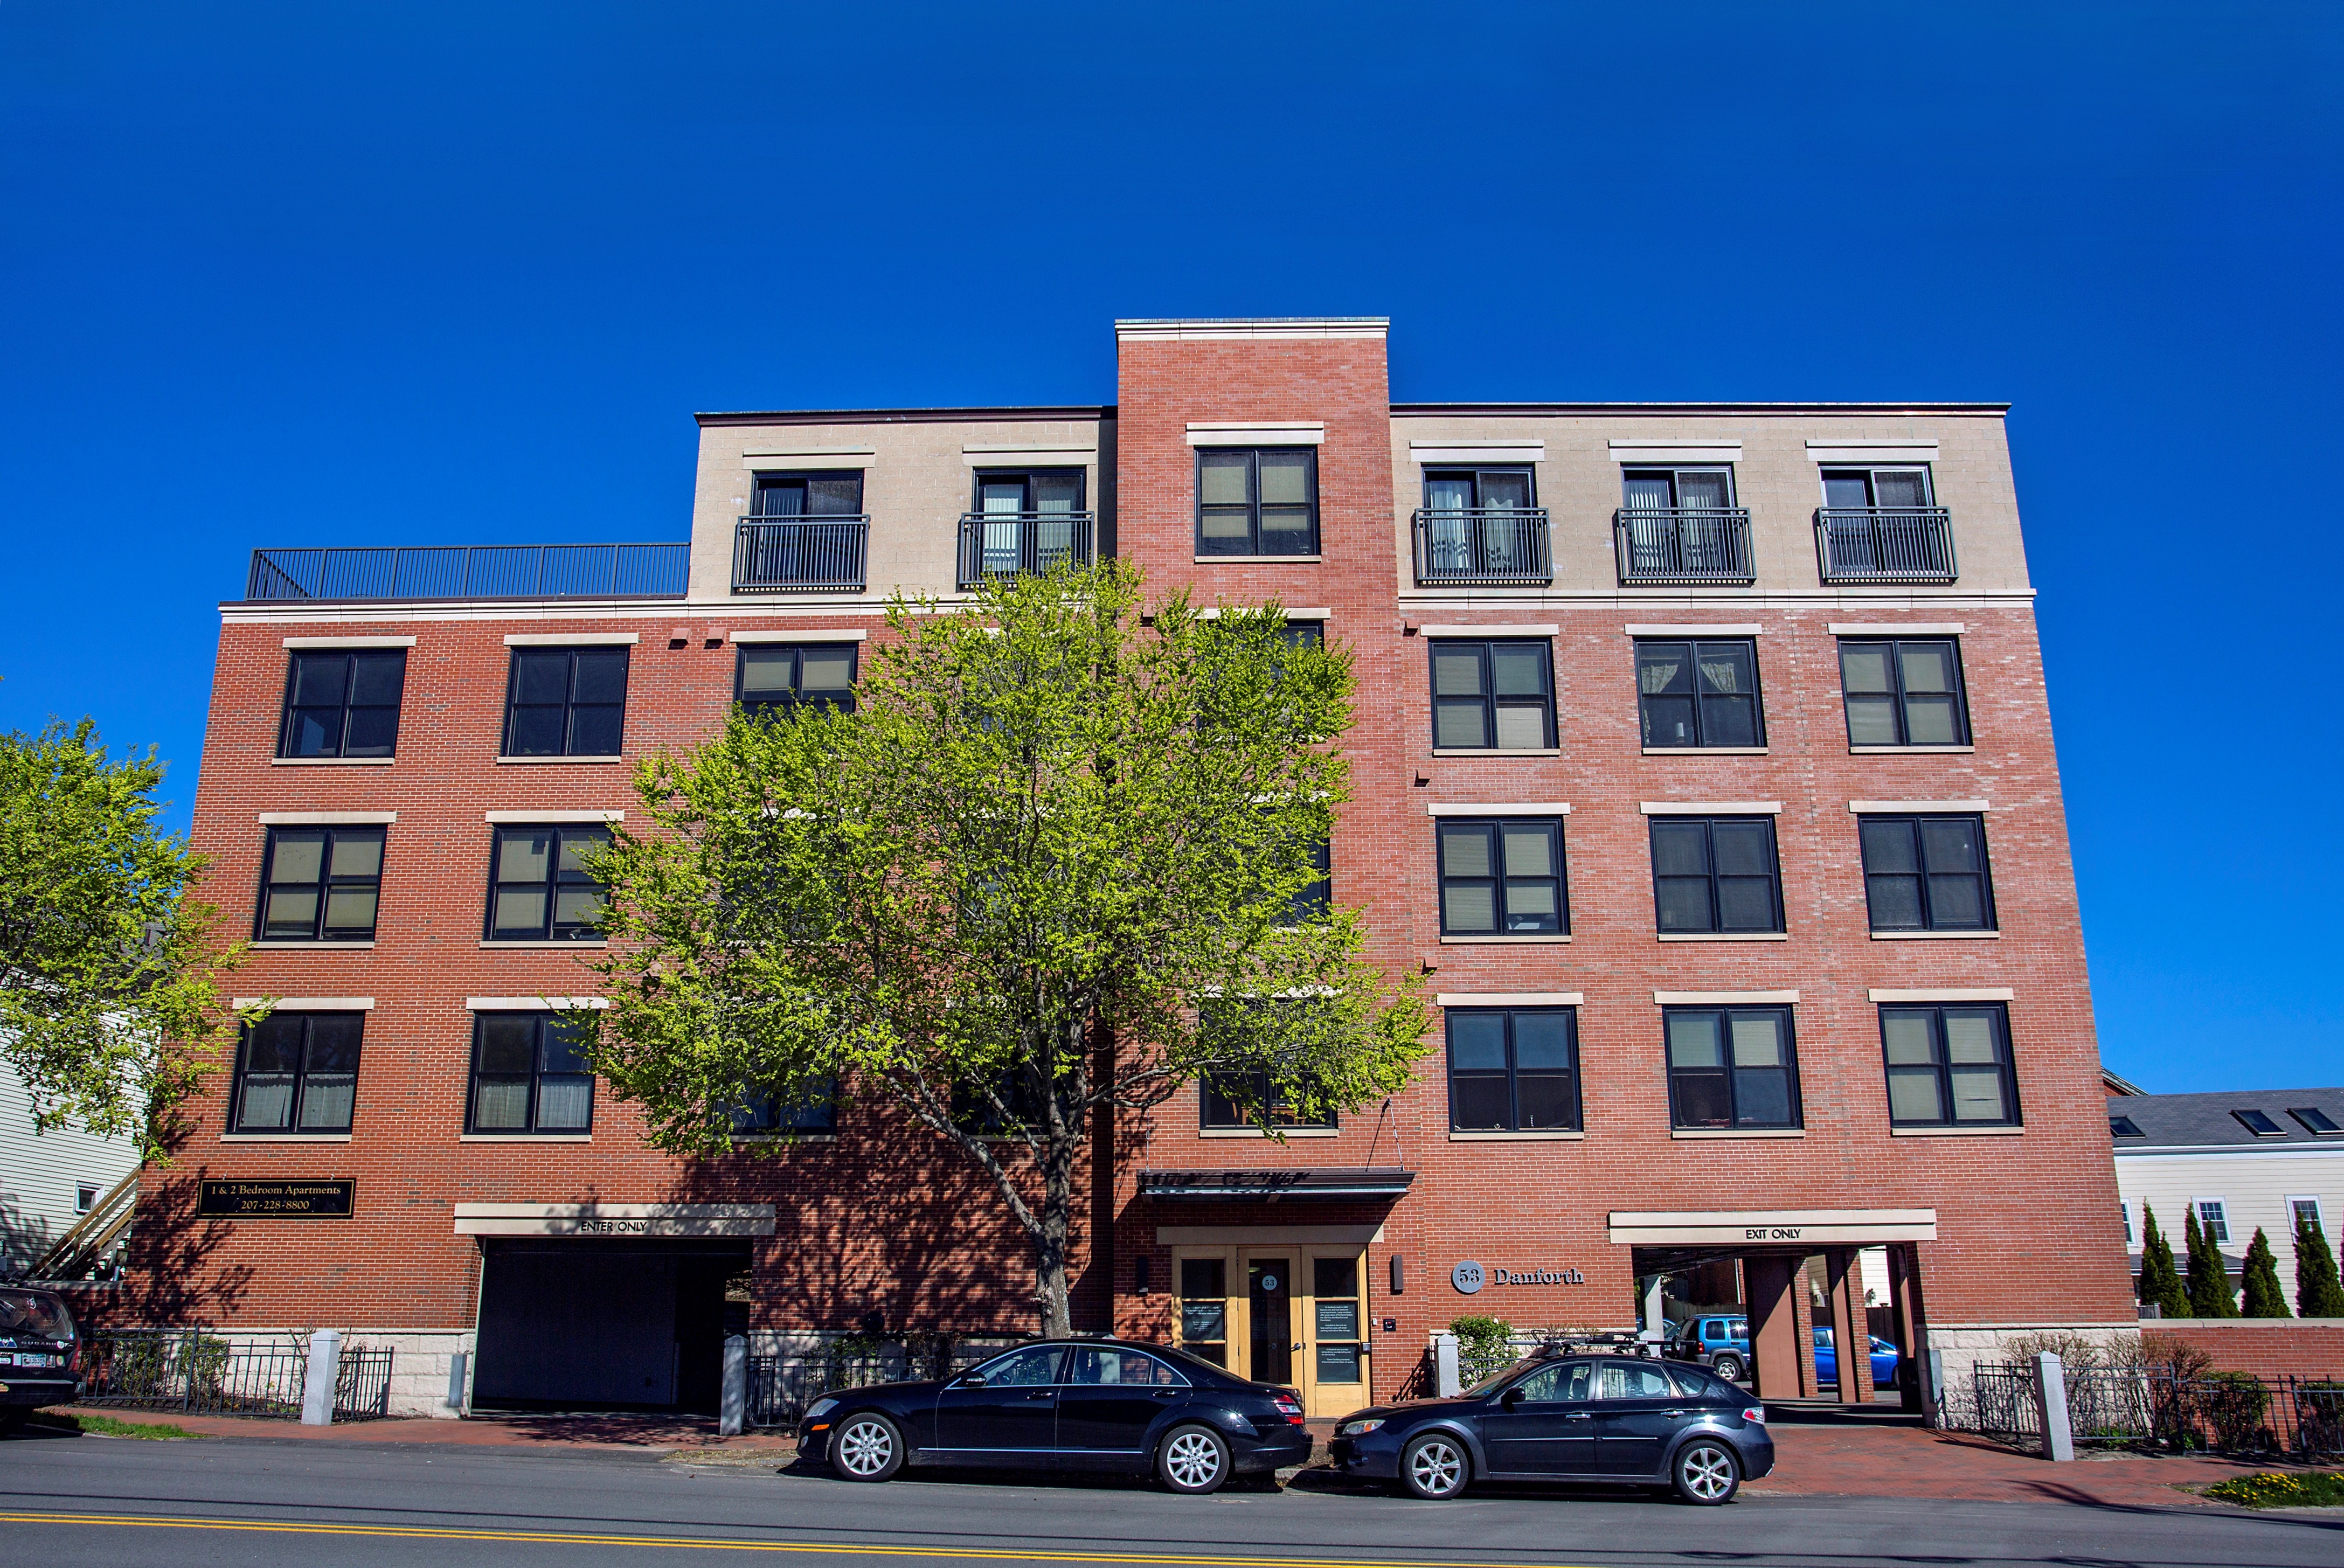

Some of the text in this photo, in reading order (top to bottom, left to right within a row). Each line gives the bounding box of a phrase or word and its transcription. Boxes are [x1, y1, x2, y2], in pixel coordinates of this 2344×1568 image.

[212, 1186, 216, 1194] 1
[231, 1186, 236, 1194] 2
[239, 1185, 282, 1194] Bedroom
[285, 1185, 341, 1196] Apartments
[241, 1201, 309, 1209] 207-228-8800
[581, 1222, 647, 1232] ENTER ONLY
[1746, 1229, 1801, 1239] EXIT ONLY
[1459, 1268, 1585, 1285] 53 Danforth
